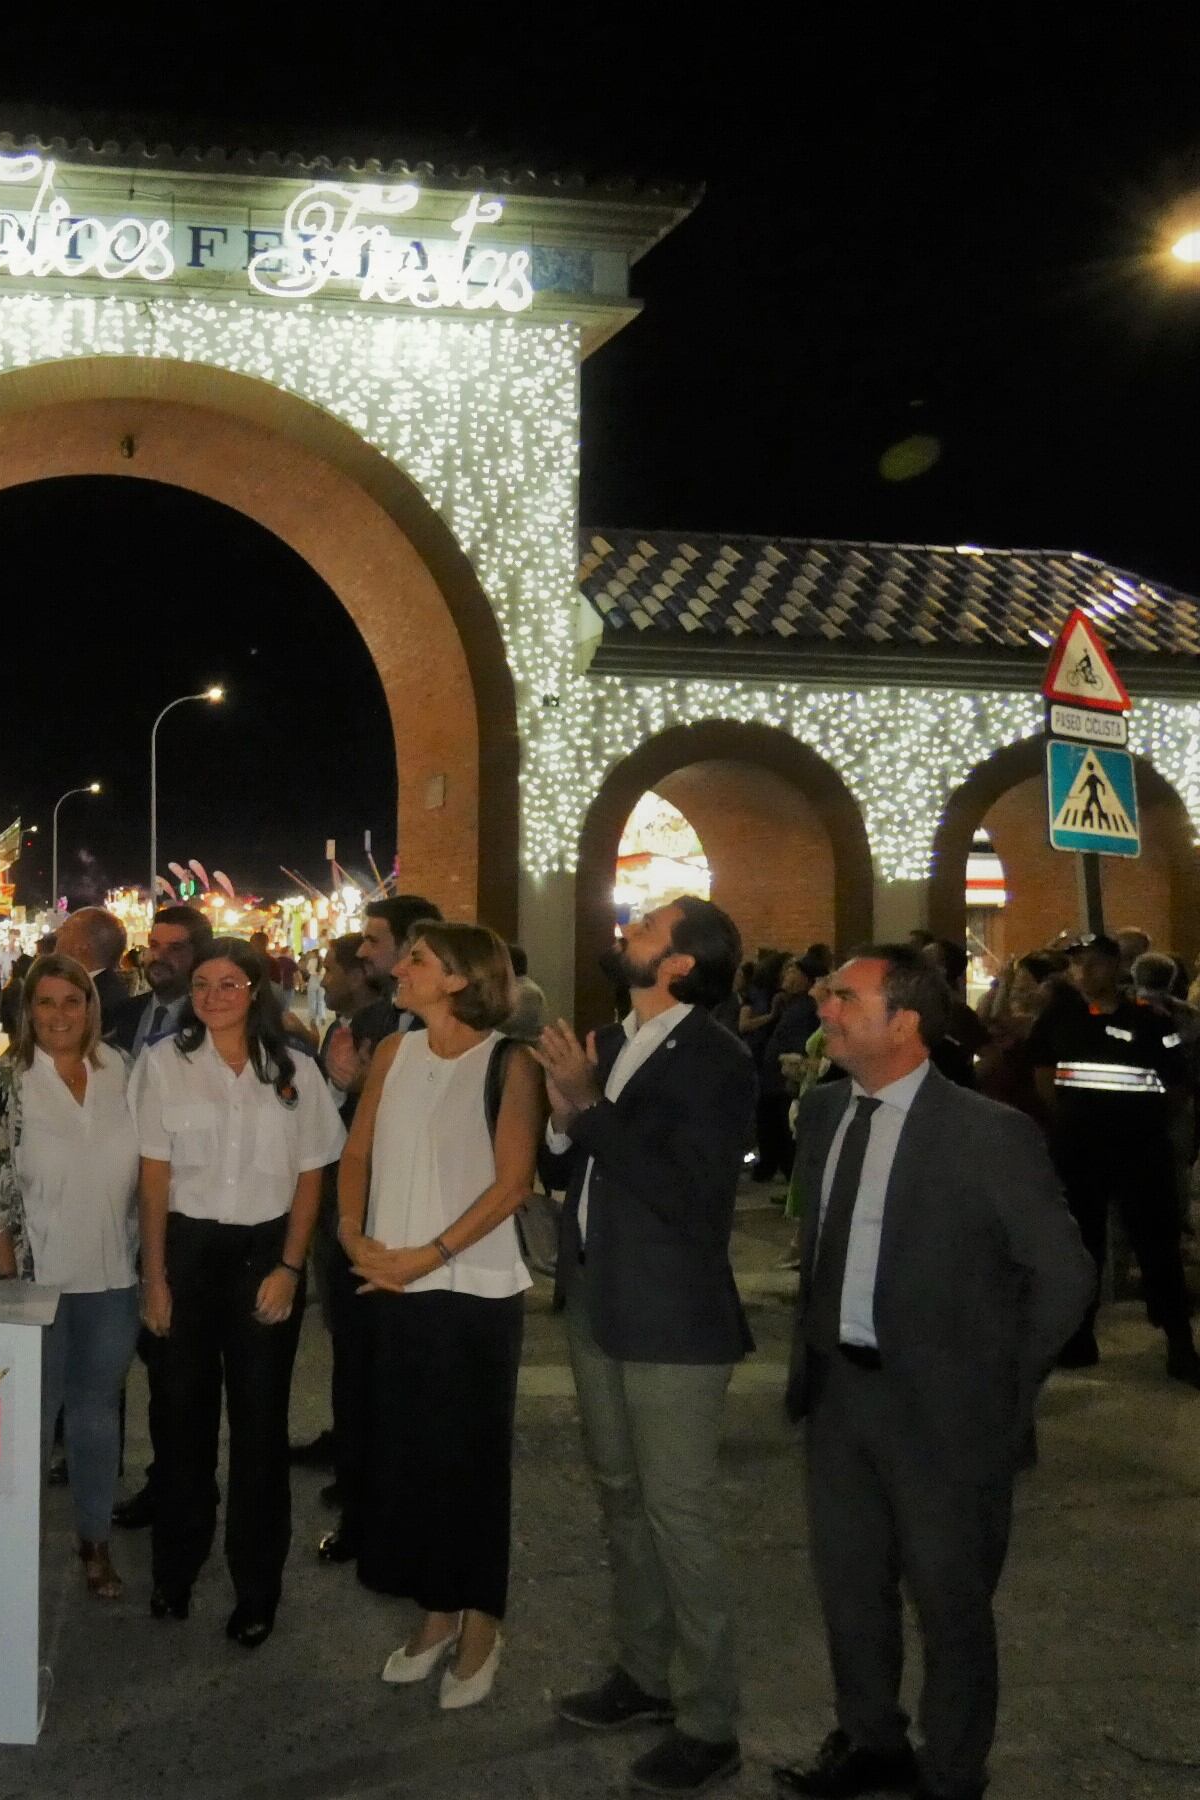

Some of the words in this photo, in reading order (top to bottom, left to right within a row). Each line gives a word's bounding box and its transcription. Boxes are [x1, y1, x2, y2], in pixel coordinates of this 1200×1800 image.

[186, 224, 497, 288] FEIL
[249, 183, 533, 312] Fiestas
[1055, 711, 1081, 731] PASEO
[1085, 716, 1122, 737] CICLISTA
